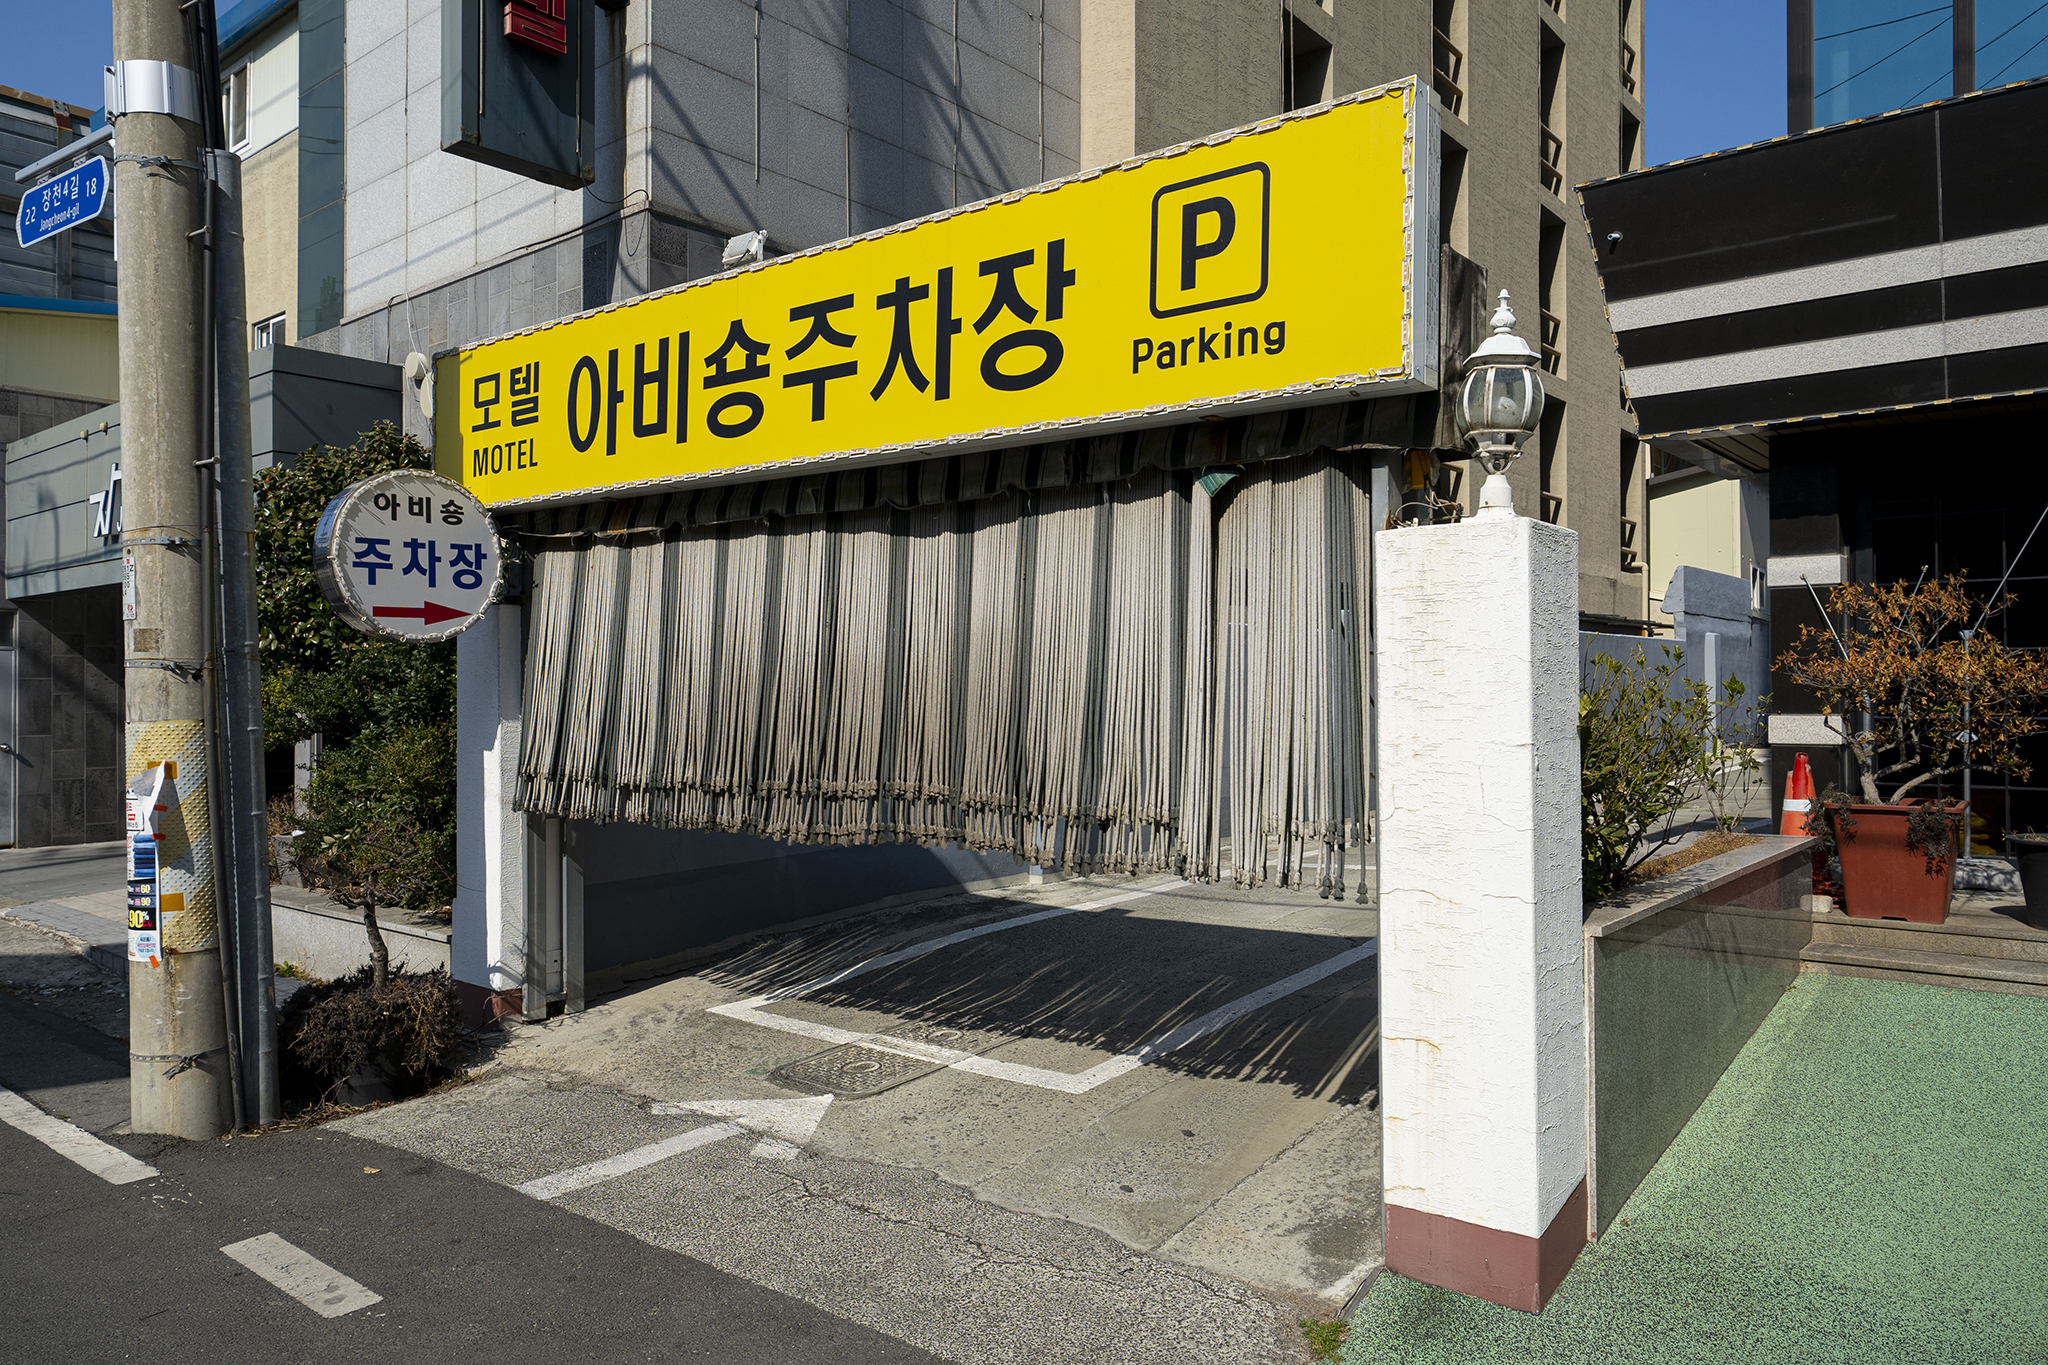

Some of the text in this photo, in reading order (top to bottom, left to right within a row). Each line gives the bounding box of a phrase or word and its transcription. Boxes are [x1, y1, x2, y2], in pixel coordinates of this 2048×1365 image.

[25, 174, 97, 226] 22 장천4길 18
[1181, 196, 1236, 291] P
[567, 238, 1076, 456] 아비숑주차장
[1132, 320, 1286, 375] Parking
[471, 361, 541, 433] 모텔
[473, 438, 538, 478] MOTEL
[352, 537, 487, 590] 주차장
